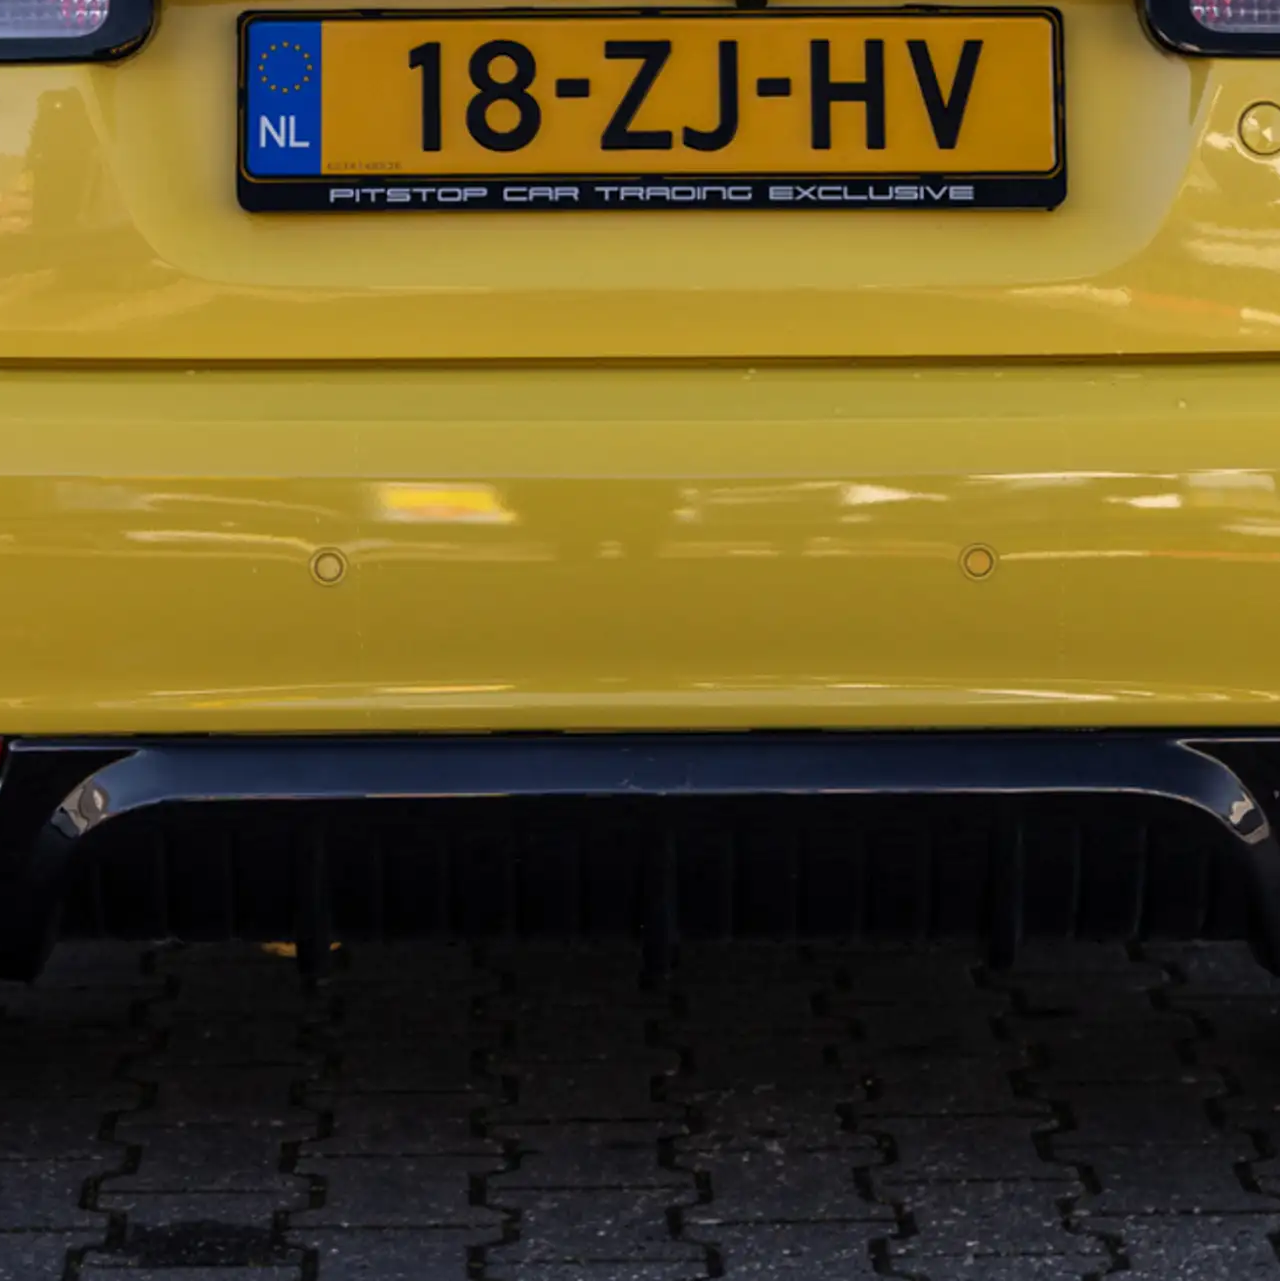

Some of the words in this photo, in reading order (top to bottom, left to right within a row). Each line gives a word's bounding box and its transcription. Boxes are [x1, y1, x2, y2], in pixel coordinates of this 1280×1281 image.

[408, 39, 983, 152] 18-ZJ-HV
[259, 115, 310, 149] NL
[329, 187, 488, 203] PITSTOP
[502, 186, 580, 202] CAR
[594, 186, 753, 201] TRADING
[769, 186, 974, 201] EXCLUSIVE
